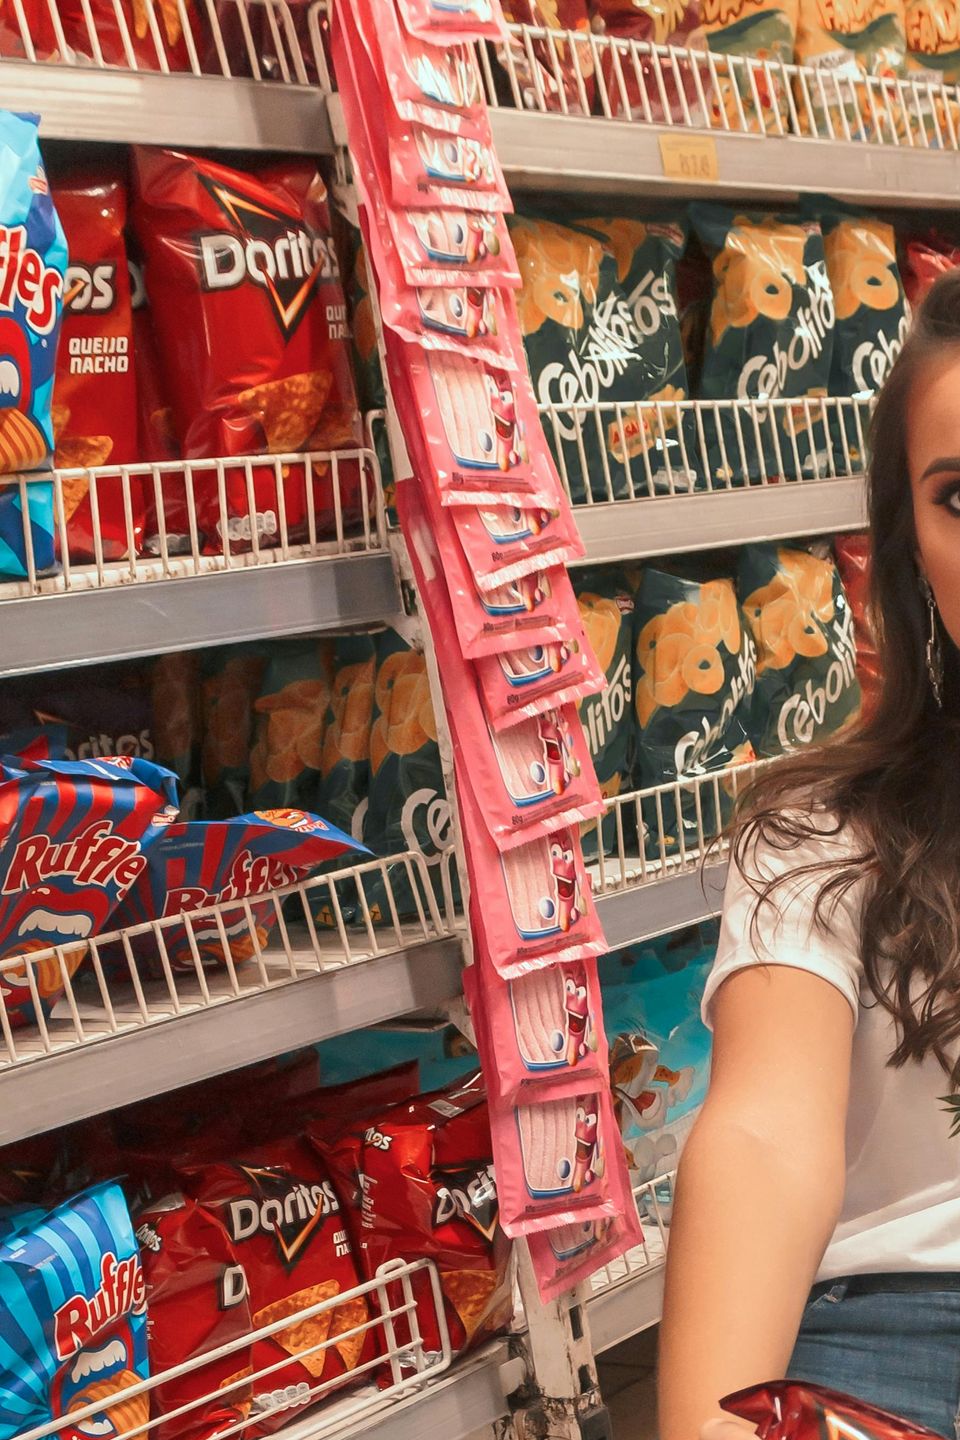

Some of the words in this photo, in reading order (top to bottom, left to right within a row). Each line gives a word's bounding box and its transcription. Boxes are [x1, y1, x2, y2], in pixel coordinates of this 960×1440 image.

[201, 230, 340, 289] Doritos
[69, 337, 129, 355] QUEIJO
[70, 355, 129, 374] NACHO
[230, 1180, 340, 1241] Doritos
